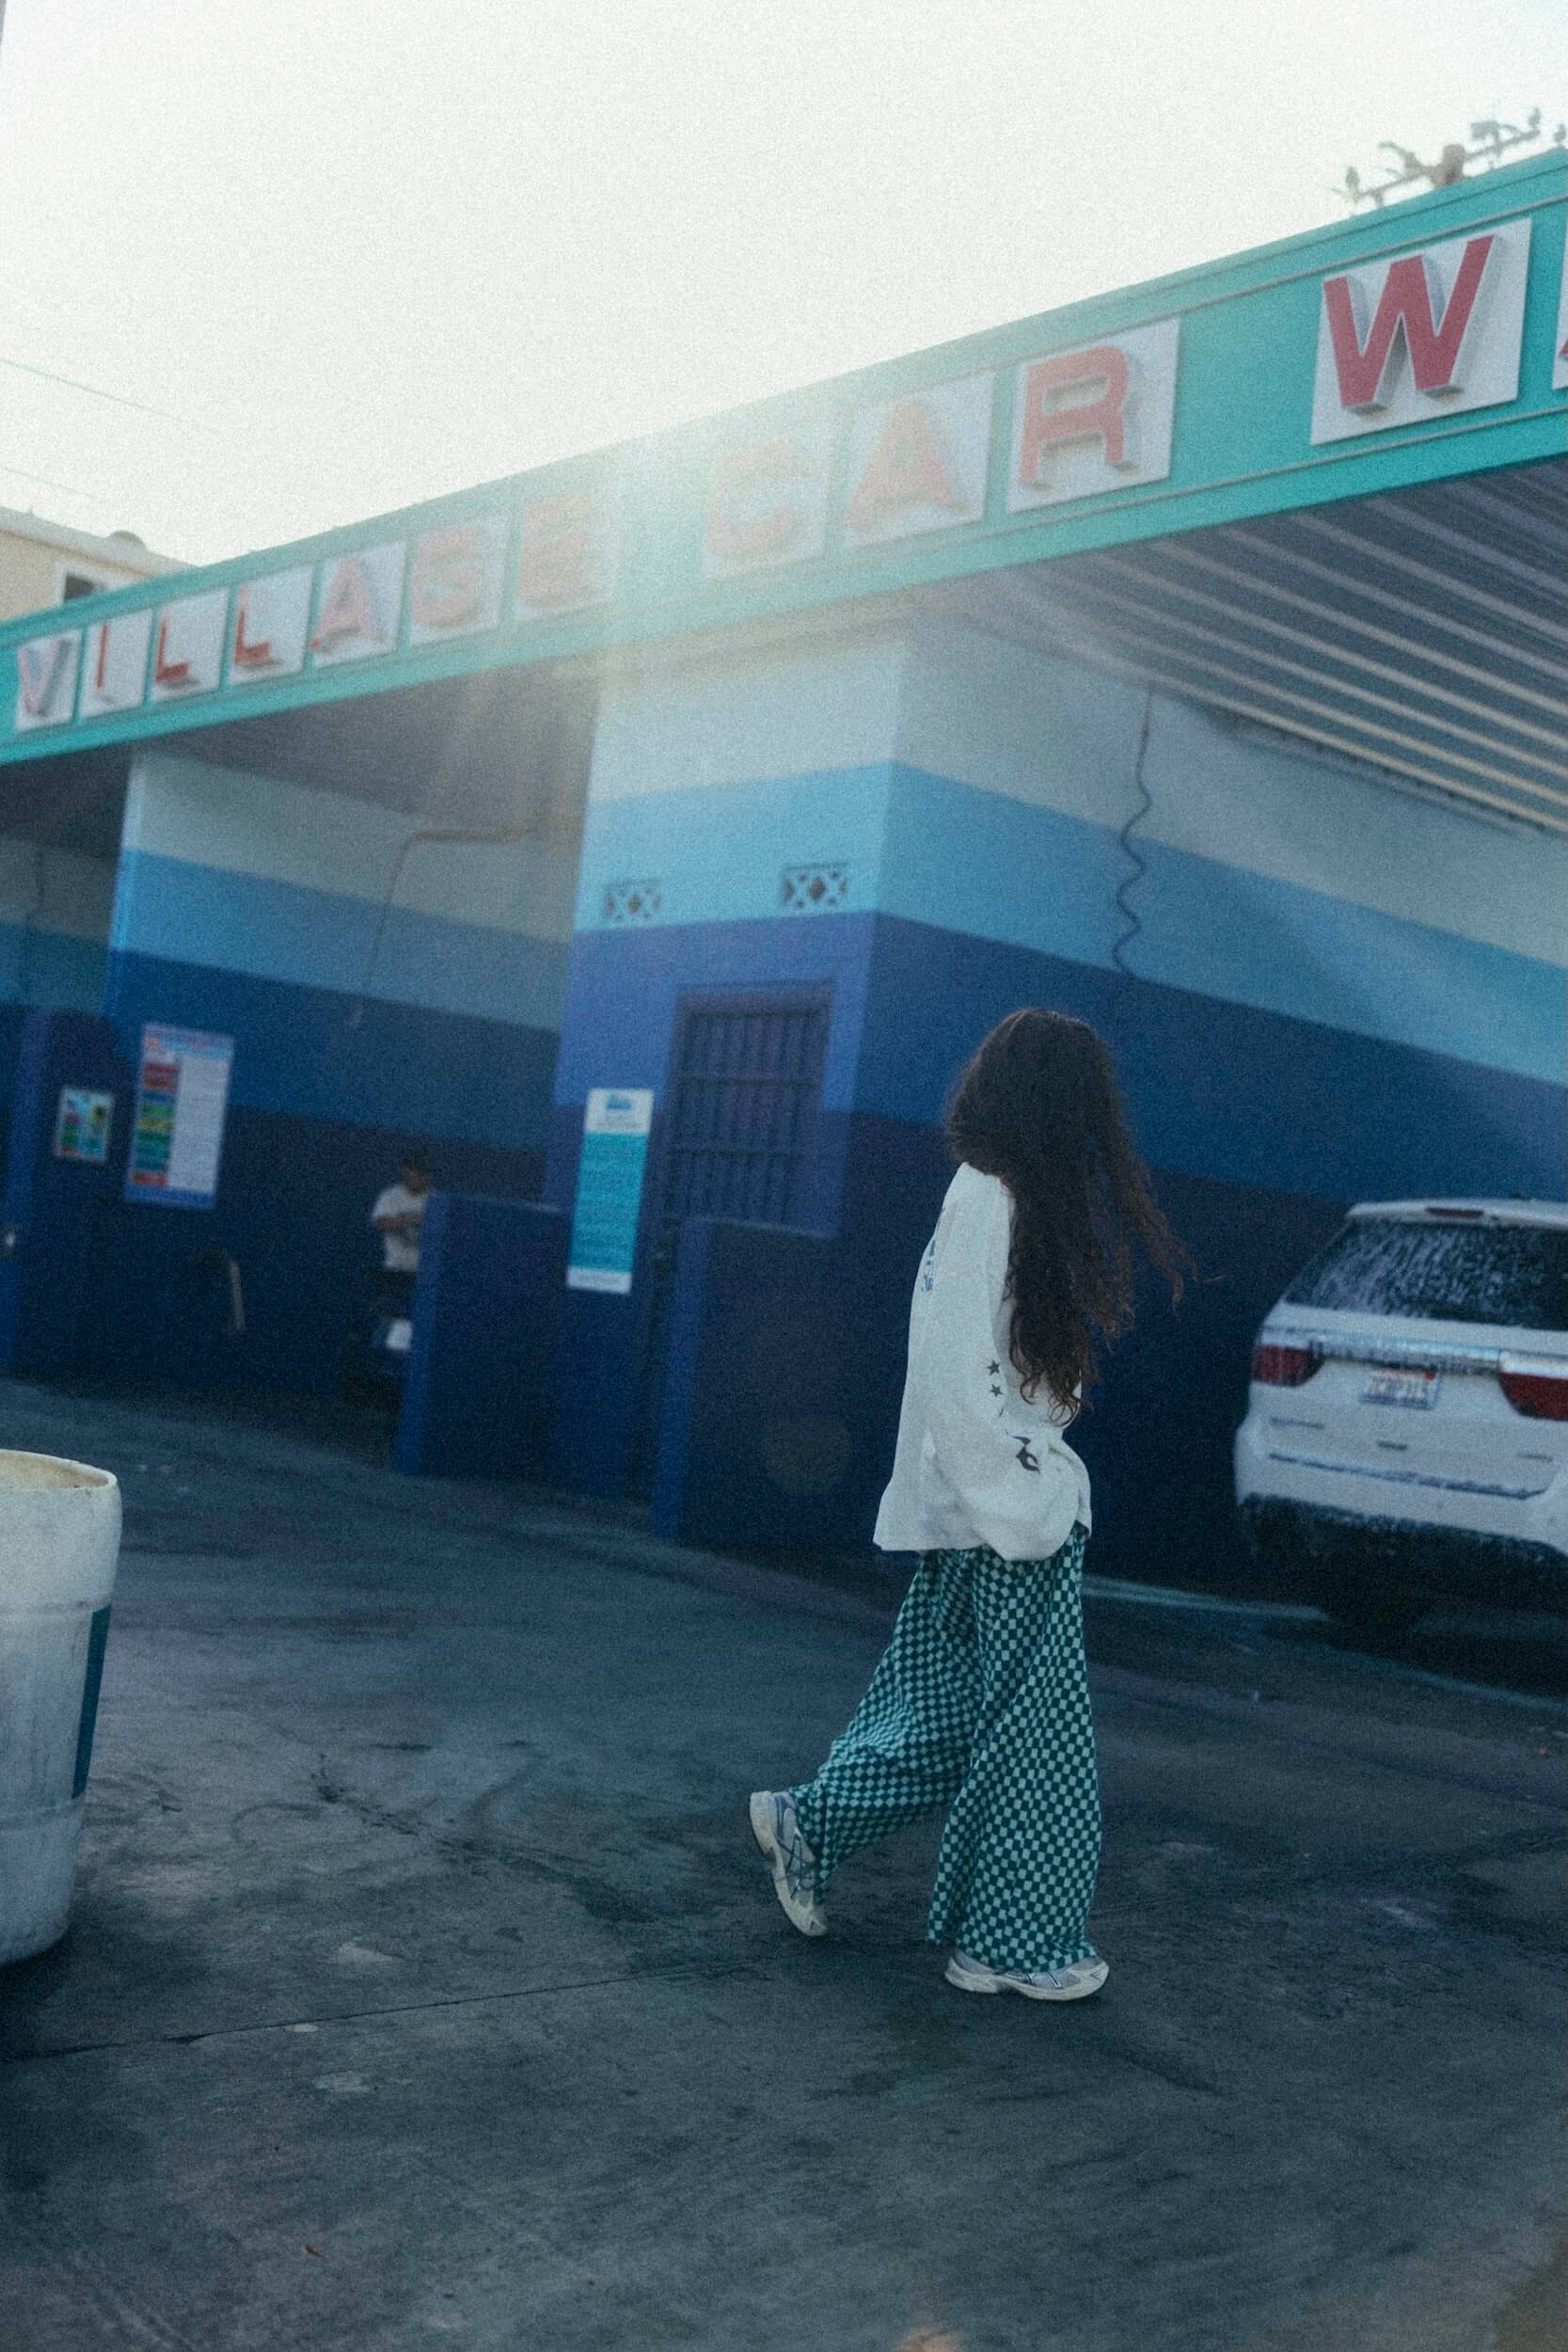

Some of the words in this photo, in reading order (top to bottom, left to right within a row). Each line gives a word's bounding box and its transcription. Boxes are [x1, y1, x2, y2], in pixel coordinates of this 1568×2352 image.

[19, 495, 593, 717] VILLAGE
[705, 344, 1132, 557] CAR
[1323, 234, 1568, 411] W
